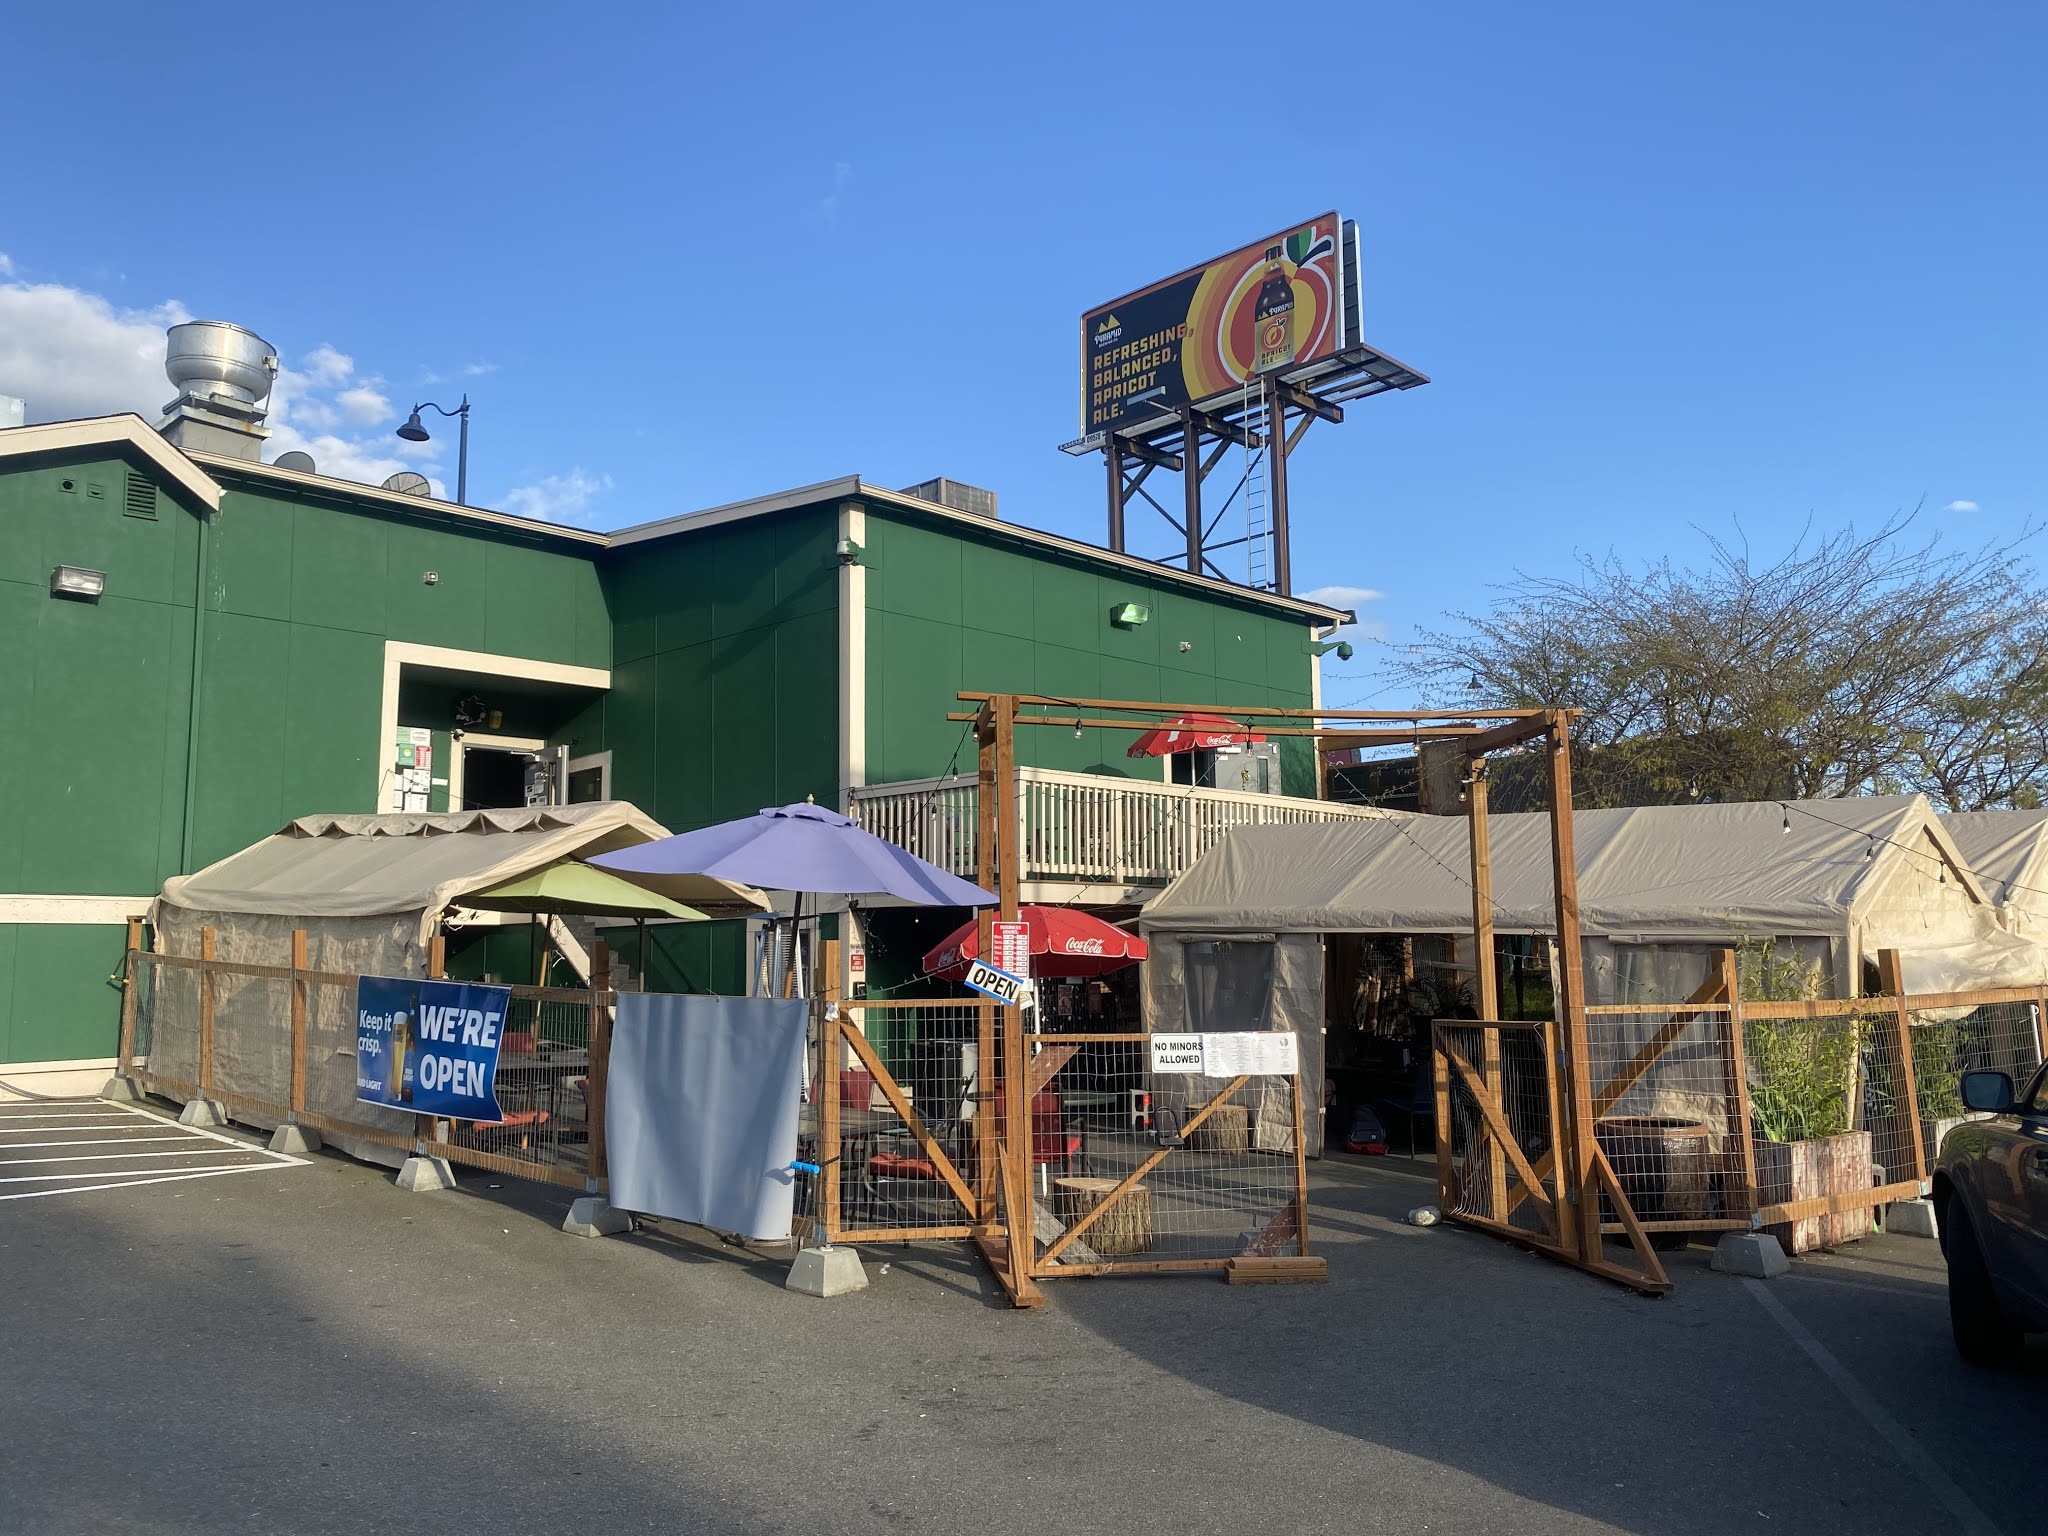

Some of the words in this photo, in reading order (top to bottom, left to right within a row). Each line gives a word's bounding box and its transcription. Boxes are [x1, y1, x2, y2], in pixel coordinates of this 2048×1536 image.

[1094, 327, 1122, 345] PYRAMID
[1094, 322, 1194, 371] REFRESHING,
[1262, 344, 1291, 360] APRICOT
[1262, 357, 1274, 365] ALE
[1094, 347, 1178, 388] BALANCED,
[1094, 371, 1157, 406] APRICOT
[1093, 403, 1124, 424] ALE.
[973, 967, 1019, 1001] OPEN
[359, 1009, 383, 1034] Keep
[384, 1012, 392, 1032] it
[419, 1004, 501, 1049] WE'RE
[358, 1033, 382, 1057] crisp.
[1154, 1042, 1168, 1051] NO
[1169, 1042, 1203, 1051] MINORS
[1159, 1055, 1200, 1064] ALLOWED
[366, 1079, 382, 1091] LIGHT
[419, 1053, 486, 1099] OPEN
